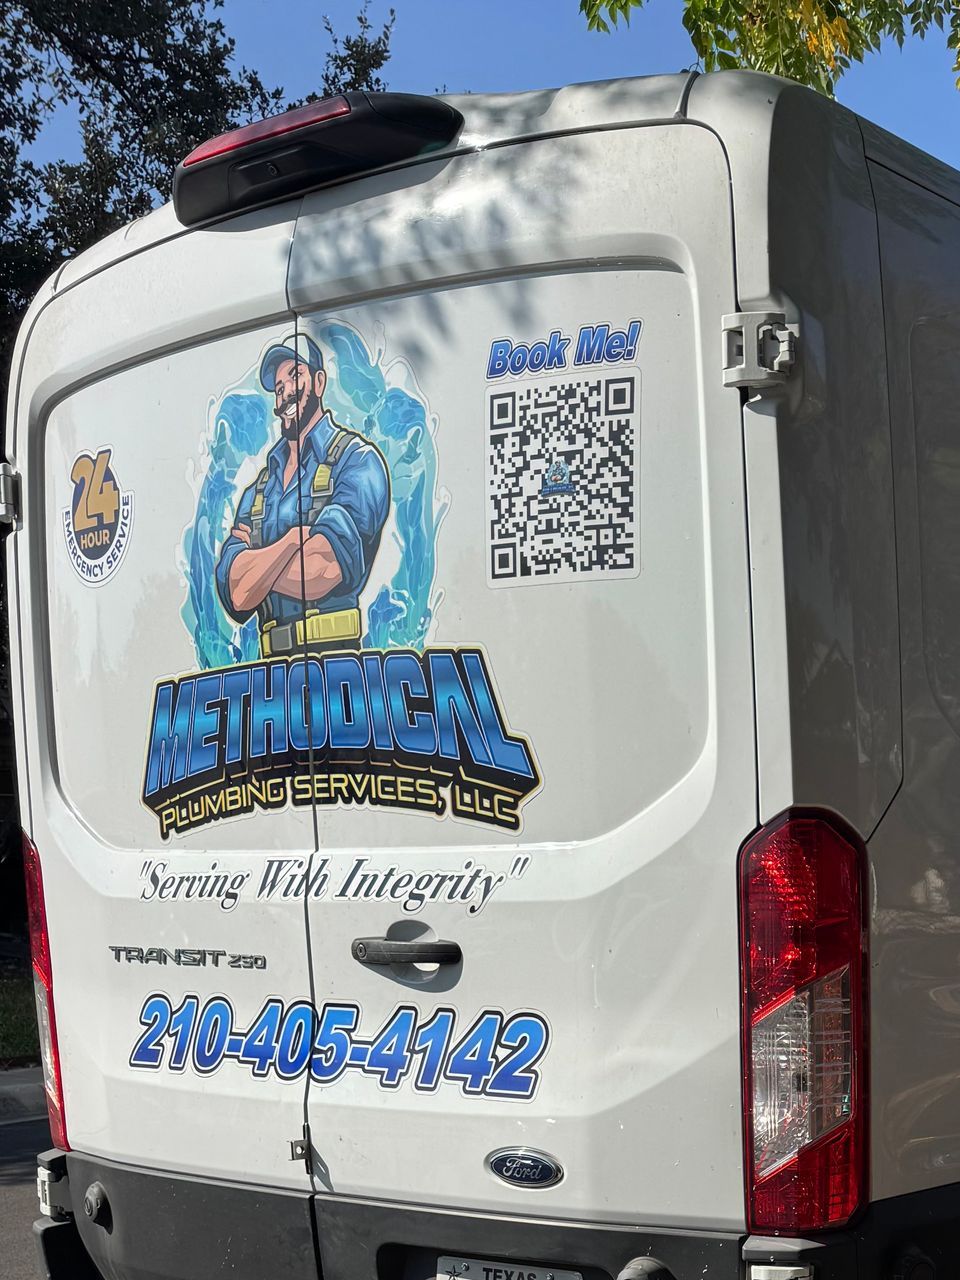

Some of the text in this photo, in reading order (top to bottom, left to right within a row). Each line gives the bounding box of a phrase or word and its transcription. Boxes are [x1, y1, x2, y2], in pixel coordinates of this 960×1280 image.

[486, 320, 642, 379] Book Me!
[71, 449, 120, 531] 24
[64, 494, 130, 578] EMERGENCY SERVICE
[80, 530, 111, 550] HOUR
[146, 653, 535, 797] METHODICAL
[160, 773, 516, 834] PLUMBING SERVICES, LLC
[140, 857, 531, 914] "Serving With Integrity"
[108, 945, 227, 967] TRANSIT
[129, 993, 550, 1099] 210-405-4142
[502, 1157, 542, 1179] Ford
